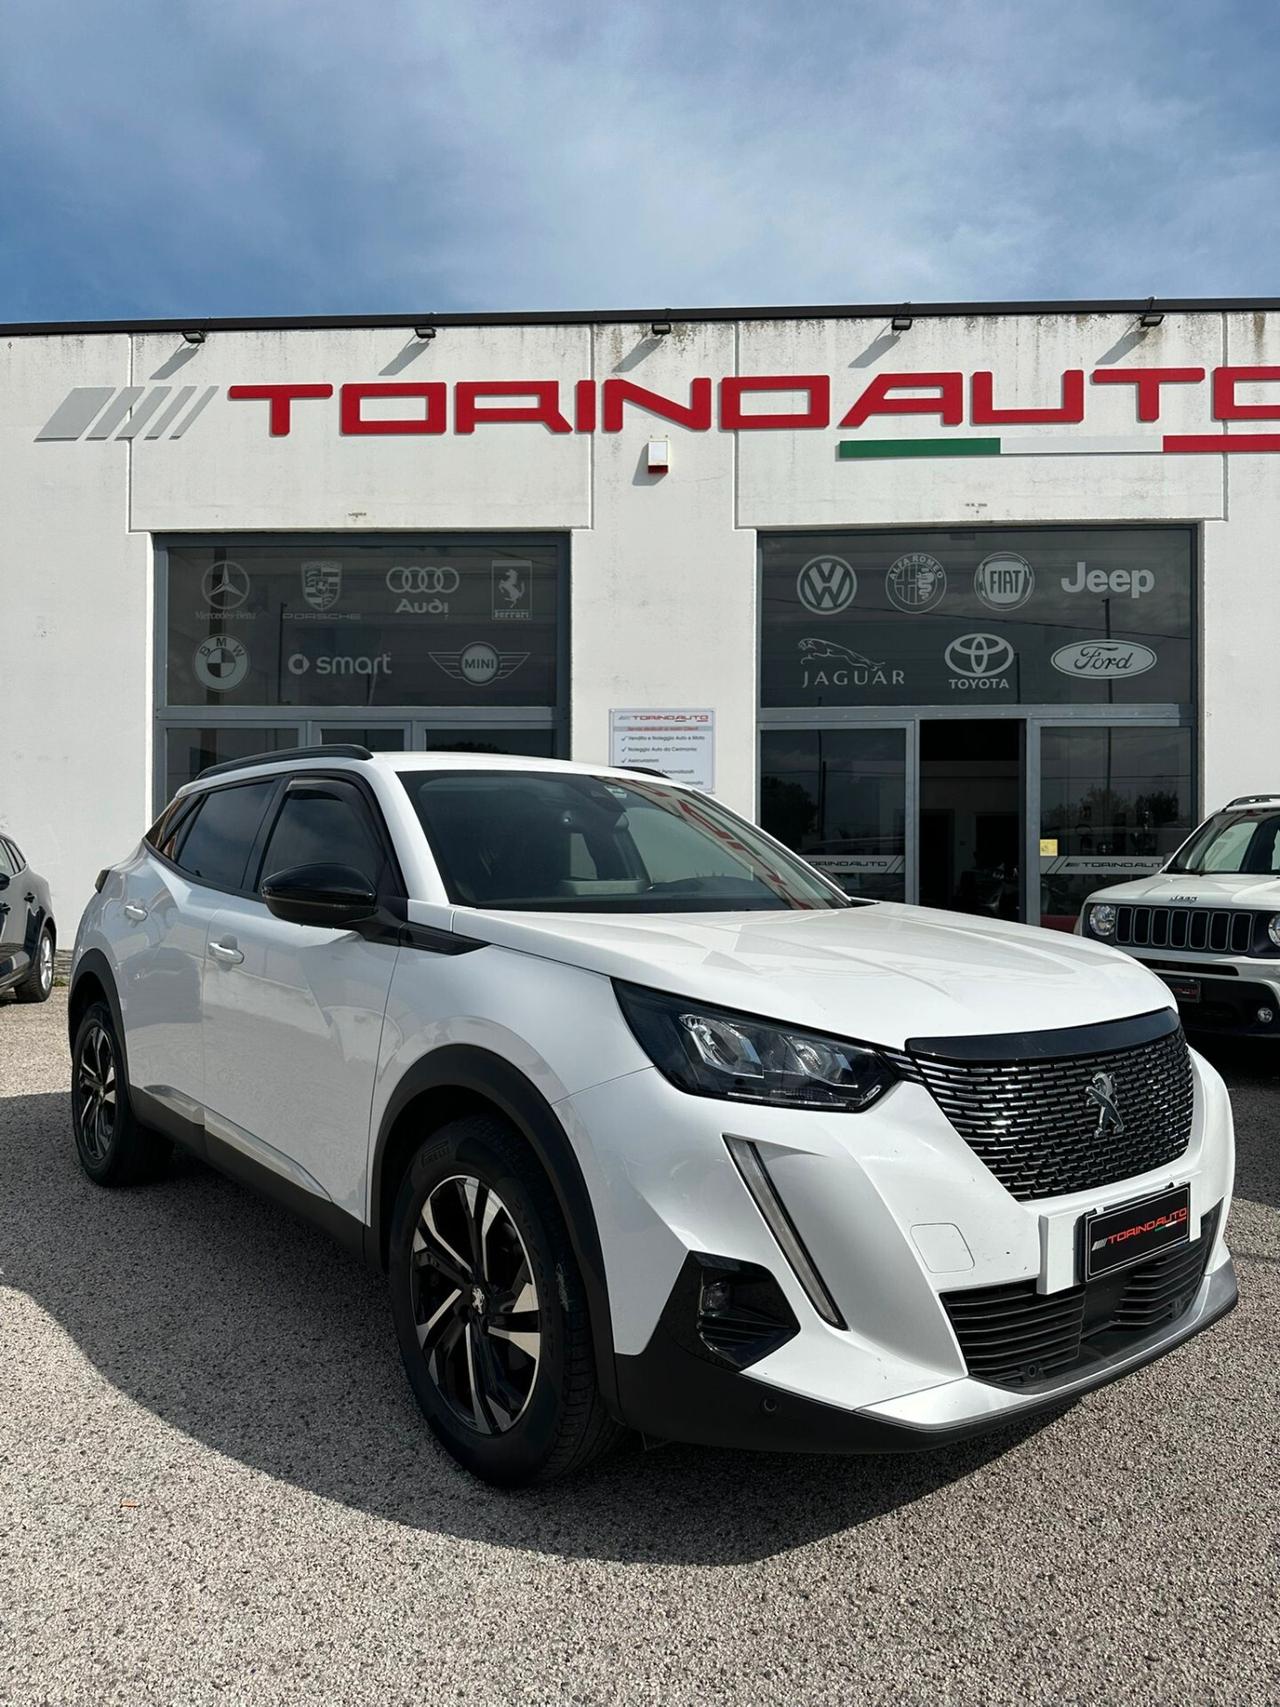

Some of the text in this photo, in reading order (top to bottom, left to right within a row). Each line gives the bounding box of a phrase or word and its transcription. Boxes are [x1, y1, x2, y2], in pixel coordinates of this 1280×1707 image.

[228, 367, 1280, 436] TORINOAUTO
[889, 555, 944, 580] ALFA ROMEO
[989, 570, 1022, 594] FIAT
[1060, 561, 1155, 599] Jeep
[282, 612, 361, 620] PORSCHE
[395, 598, 449, 615] Audi
[200, 637, 245, 657] BMW
[1073, 645, 1134, 670] Ford
[316, 653, 393, 675] smart
[464, 658, 496, 670] MINI
[802, 669, 905, 688] JAGUAR
[948, 678, 1010, 690] TOYOTA
[1107, 1206, 1188, 1245] TORINOAUTO
